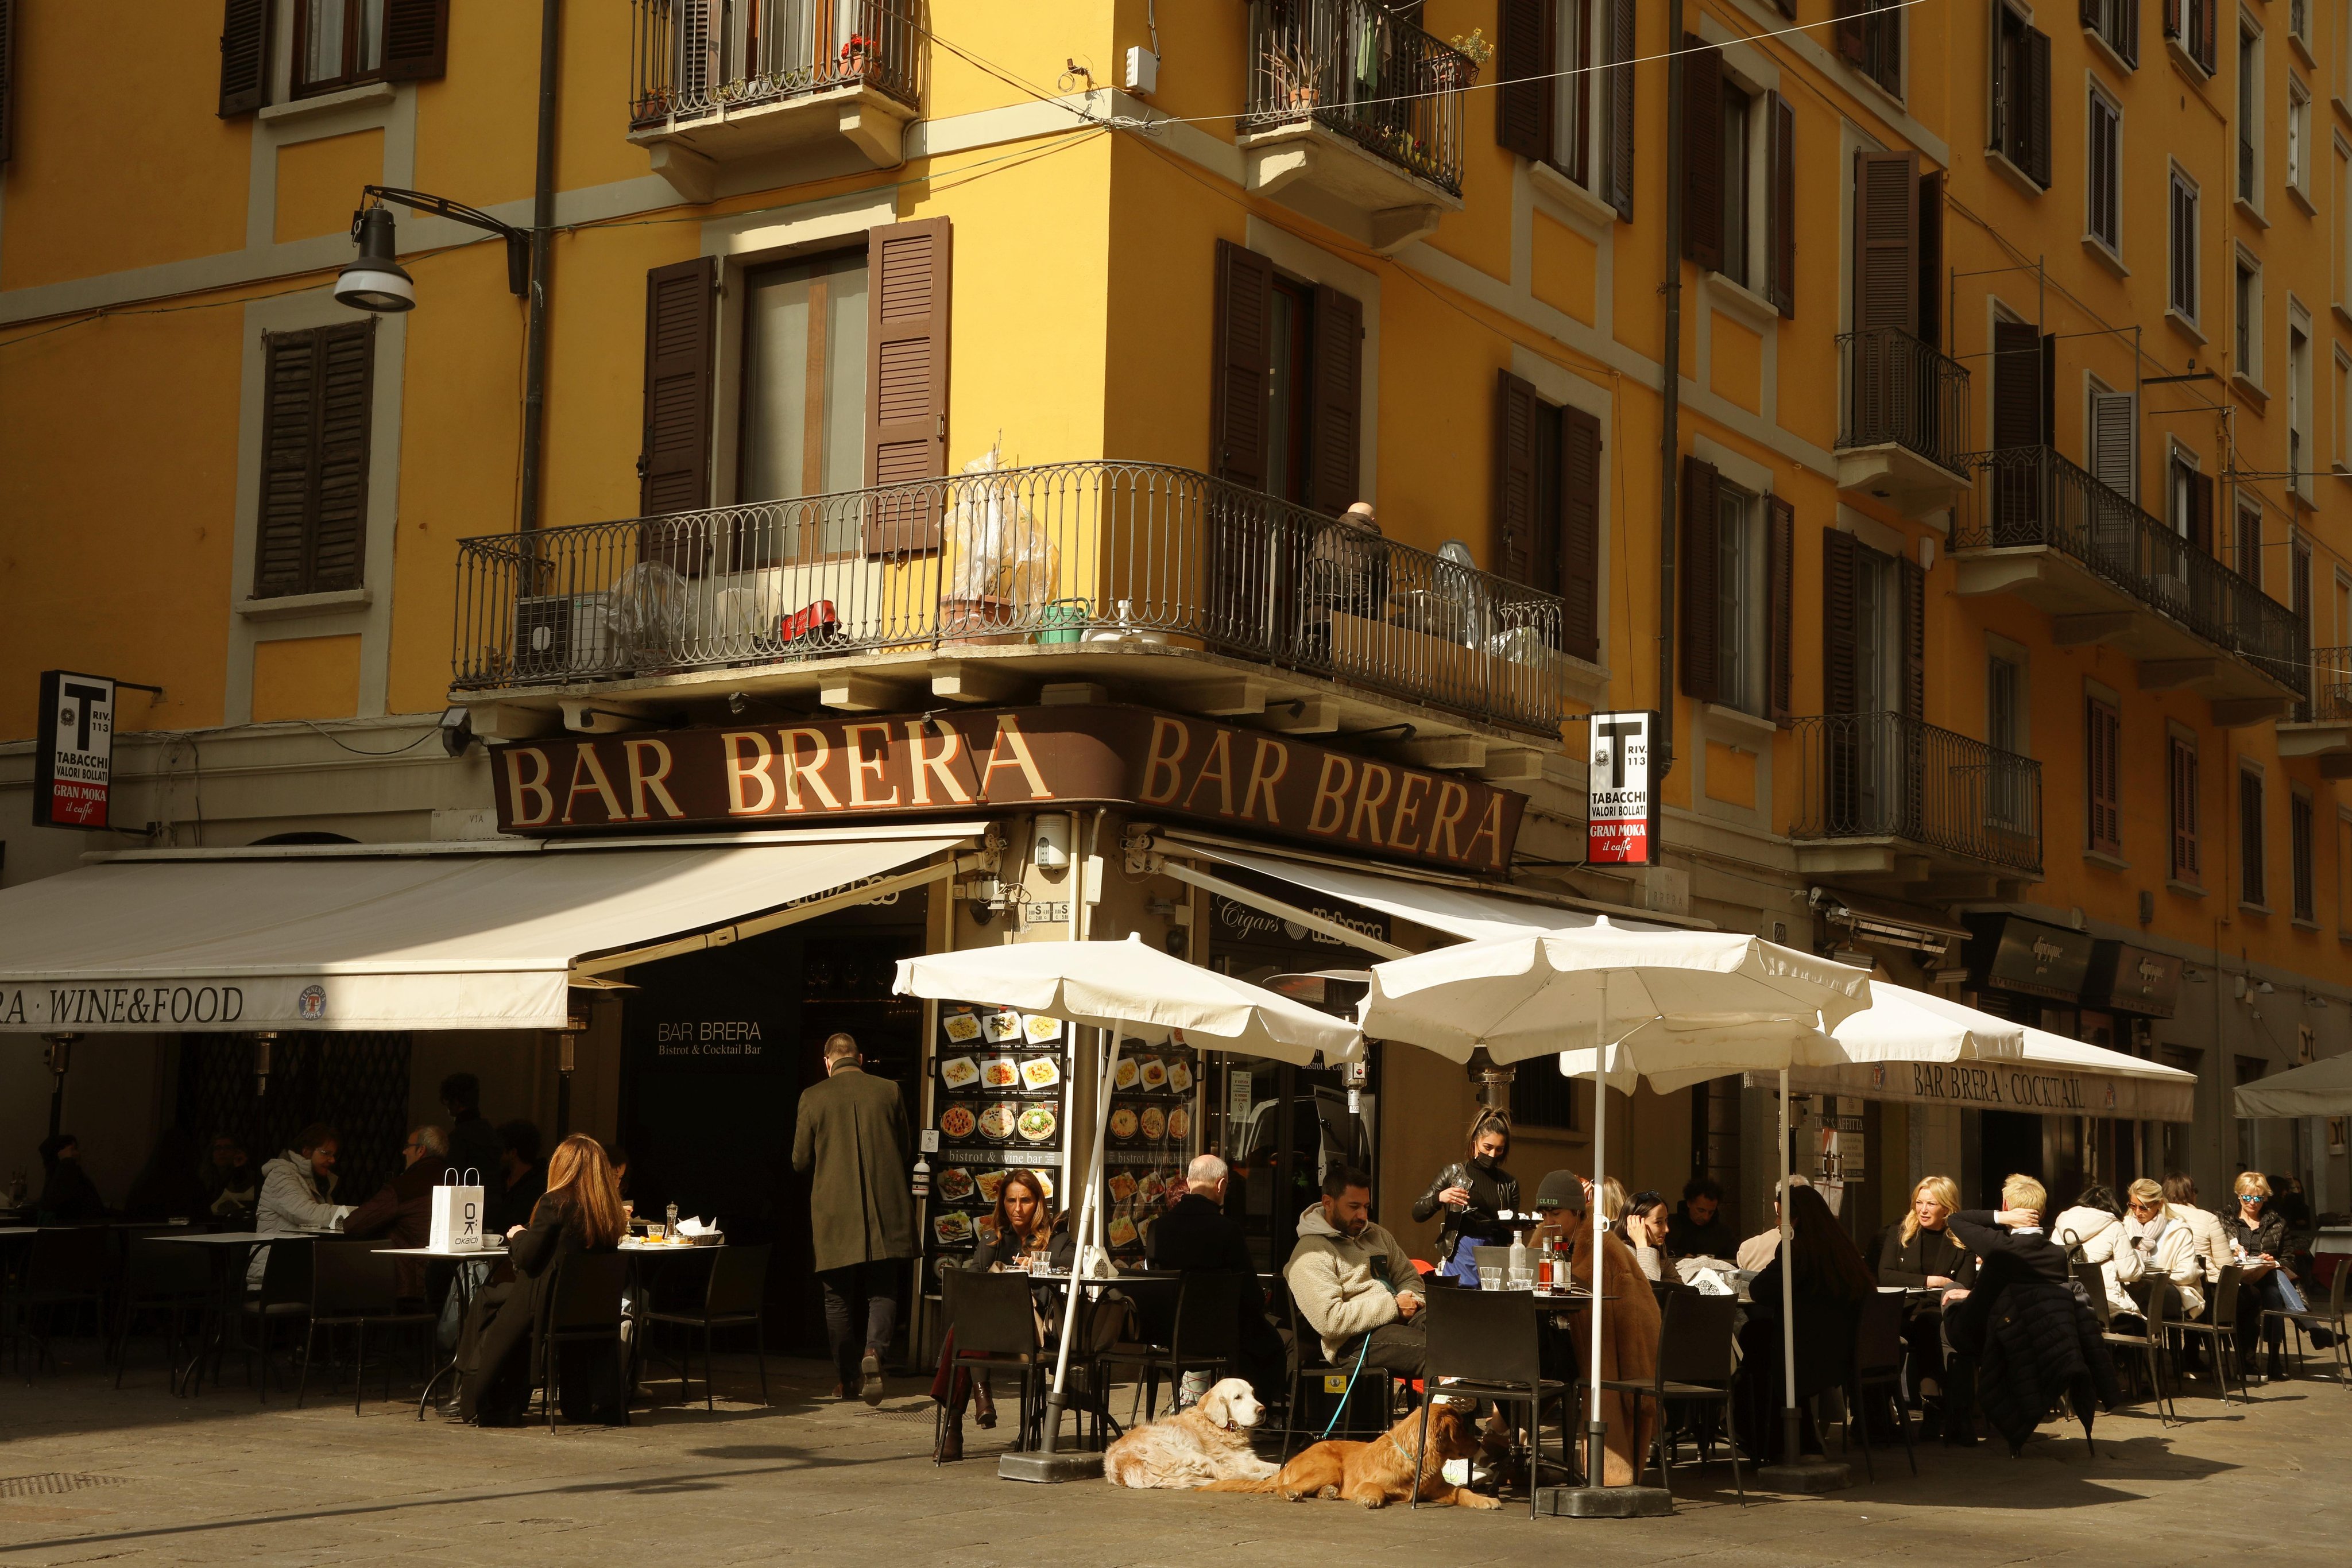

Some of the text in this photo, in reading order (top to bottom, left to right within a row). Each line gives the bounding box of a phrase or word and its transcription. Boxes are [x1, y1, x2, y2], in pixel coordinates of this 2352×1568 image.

[64, 682, 106, 751] T
[93, 711, 110, 721] RIV.
[92, 722, 109, 732] 113
[1598, 721, 1642, 788] T
[1628, 746, 1647, 754] RIV.
[57, 752, 108, 769] TABACCHI
[1628, 757, 1646, 765] 113
[56, 765, 107, 782] VALORI BOLLATI
[502, 714, 1054, 827] BAR BRERA
[54, 784, 106, 802] GRAN MOKA
[1139, 715, 1504, 868] BAR BRERA
[1592, 791, 1646, 804] TABACCHI
[65, 802, 73, 811] il
[1592, 805, 1646, 817] VALORI BOLLATI
[1590, 824, 1646, 837] GRAN MOKA
[1603, 841, 1609, 851] il
[1654, 891, 1682, 906] BRERA
[1035, 905, 1041, 915] S
[1062, 904, 1067, 914] S
[1216, 894, 1279, 939] Cigars
[300, 986, 326, 1001] TENNENT'S
[0, 987, 243, 1024] A WINE&FOOD
[302, 1010, 321, 1019] SUPER
[659, 1022, 761, 1042] BAR BRERA
[659, 1044, 761, 1055] Bistrot & Cocktail Bar
[1914, 1063, 1945, 1098] BAR
[1951, 1067, 2002, 1103] BRERA
[2011, 1073, 2085, 1109] COCKTAIL
[1838, 1118, 1863, 1130] AFFITTA
[949, 1150, 982, 1162] bistrot
[988, 1151, 996, 1163] &
[1001, 1152, 1023, 1163] wine
[1027, 1152, 1042, 1164] bar
[1118, 1152, 1144, 1163] bistrot
[1147, 1153, 1153, 1163] &
[1156, 1153, 1172, 1164] wine
